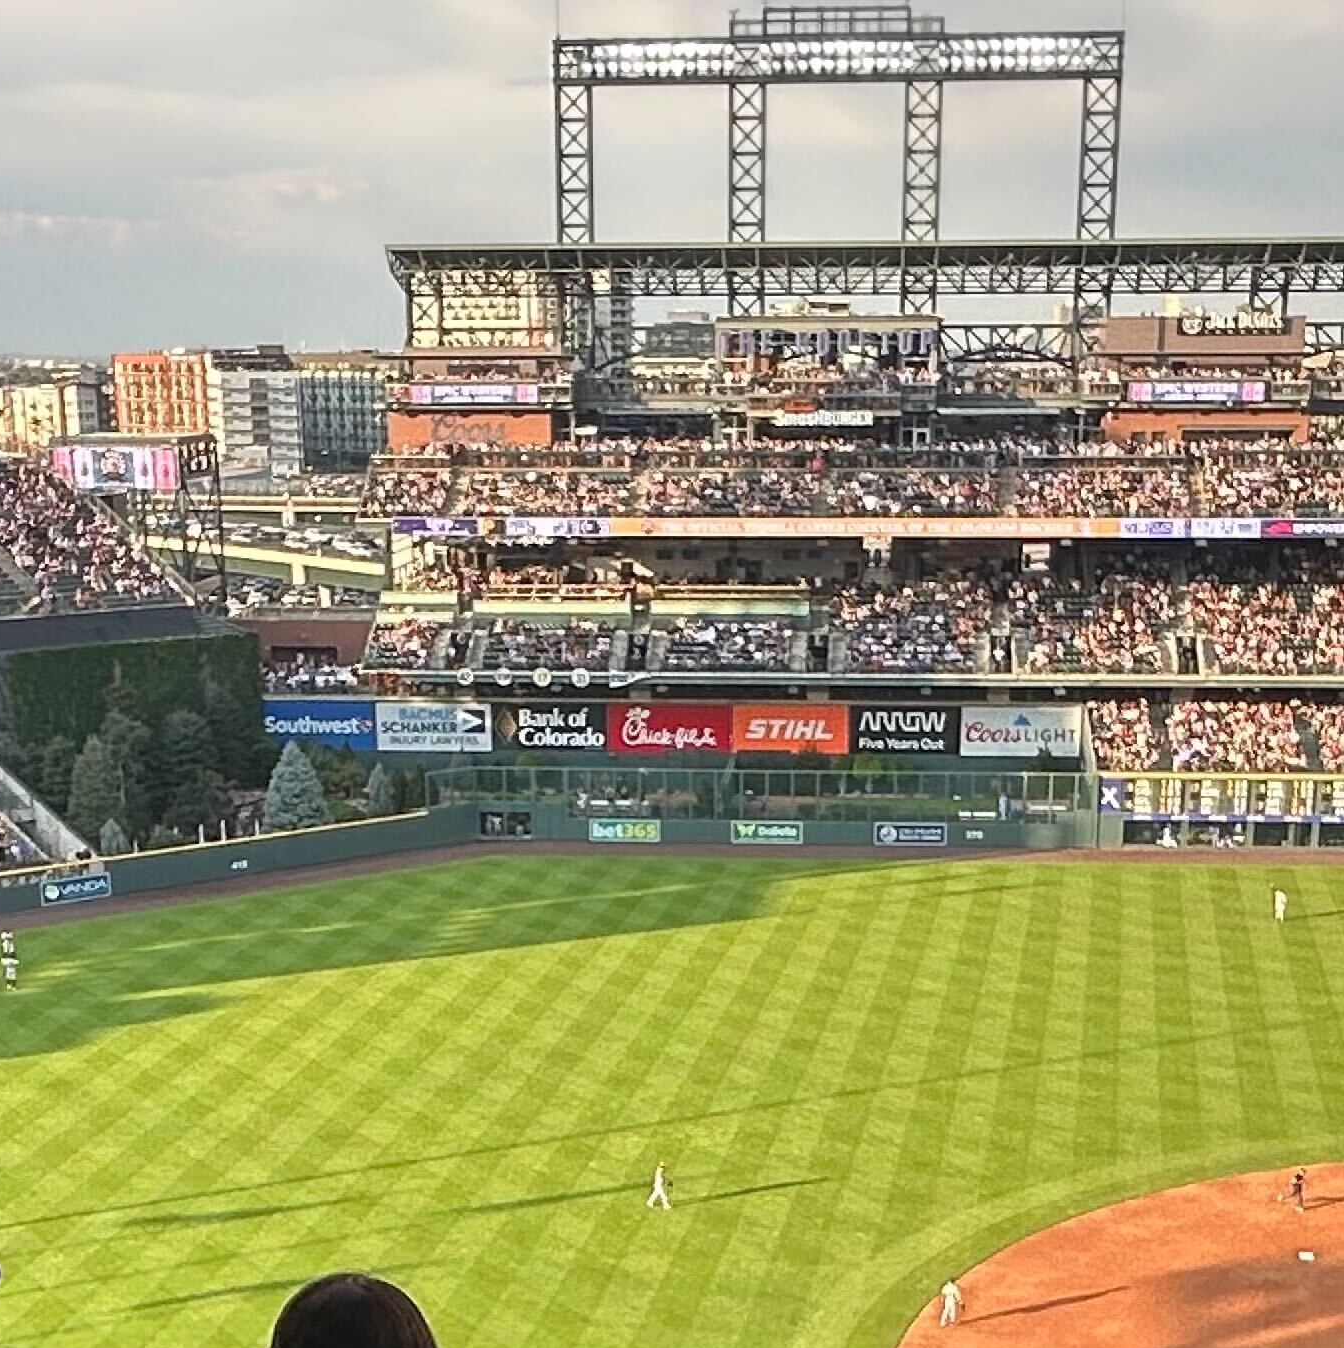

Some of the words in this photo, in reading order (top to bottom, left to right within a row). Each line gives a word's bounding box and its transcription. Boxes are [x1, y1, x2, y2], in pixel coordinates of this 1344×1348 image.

[264, 716, 361, 736] Southwest
[380, 721, 459, 733] SCHANKER
[519, 708, 558, 727] Bank
[561, 708, 588, 727] of
[519, 729, 606, 748] Colorado
[744, 718, 834, 741] STIHL
[964, 720, 1023, 744] Coors
[1024, 728, 1076, 743] LIGHT
[858, 737, 884, 750] Five
[885, 737, 920, 750] Years
[920, 737, 945, 750] Out
[592, 822, 658, 839] bet365
[59, 878, 108, 896] VANDA
